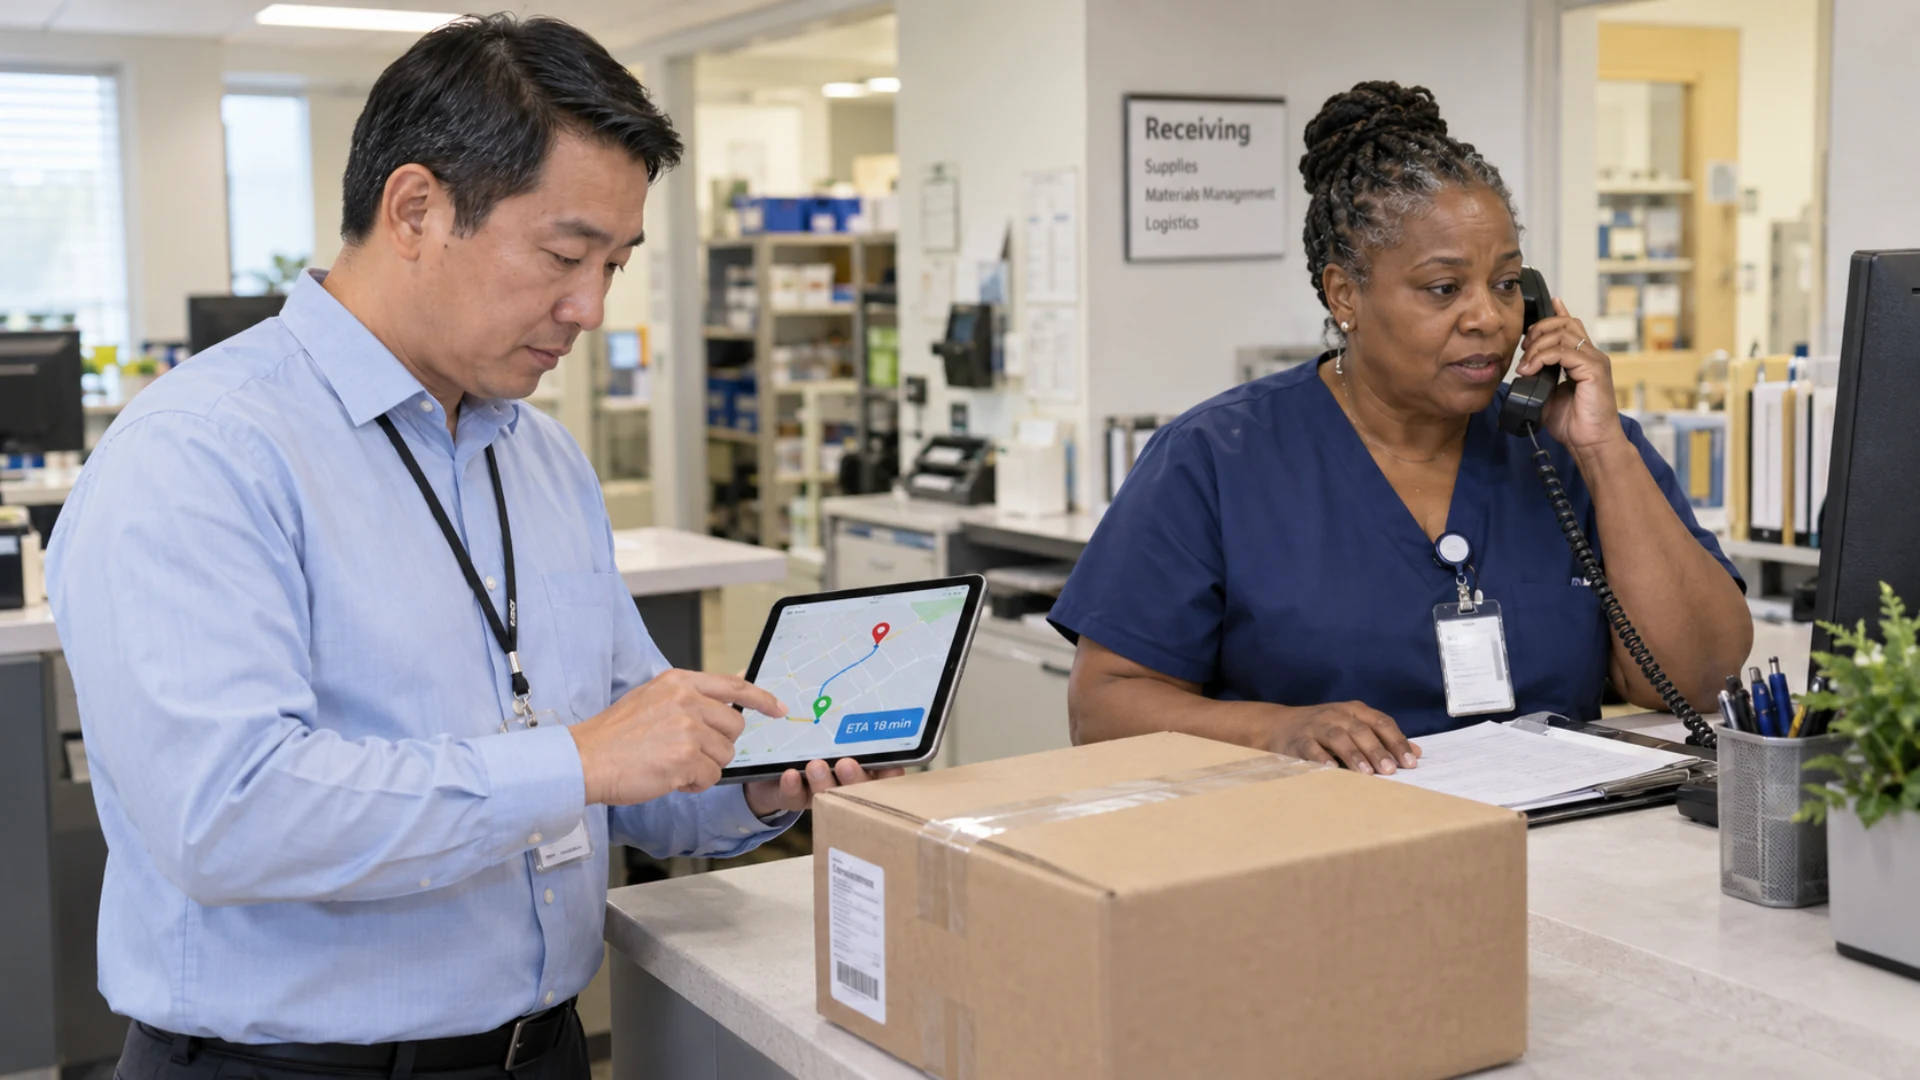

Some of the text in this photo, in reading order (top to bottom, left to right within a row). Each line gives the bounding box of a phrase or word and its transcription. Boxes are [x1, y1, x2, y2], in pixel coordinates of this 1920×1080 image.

[1145, 116, 1251, 147] Receiving
[1145, 157, 1199, 177] Supplies
[1145, 186, 1276, 205] Materials Management
[1145, 213, 1200, 235] Logistics
[845, 718, 912, 735] ETA 18 min
